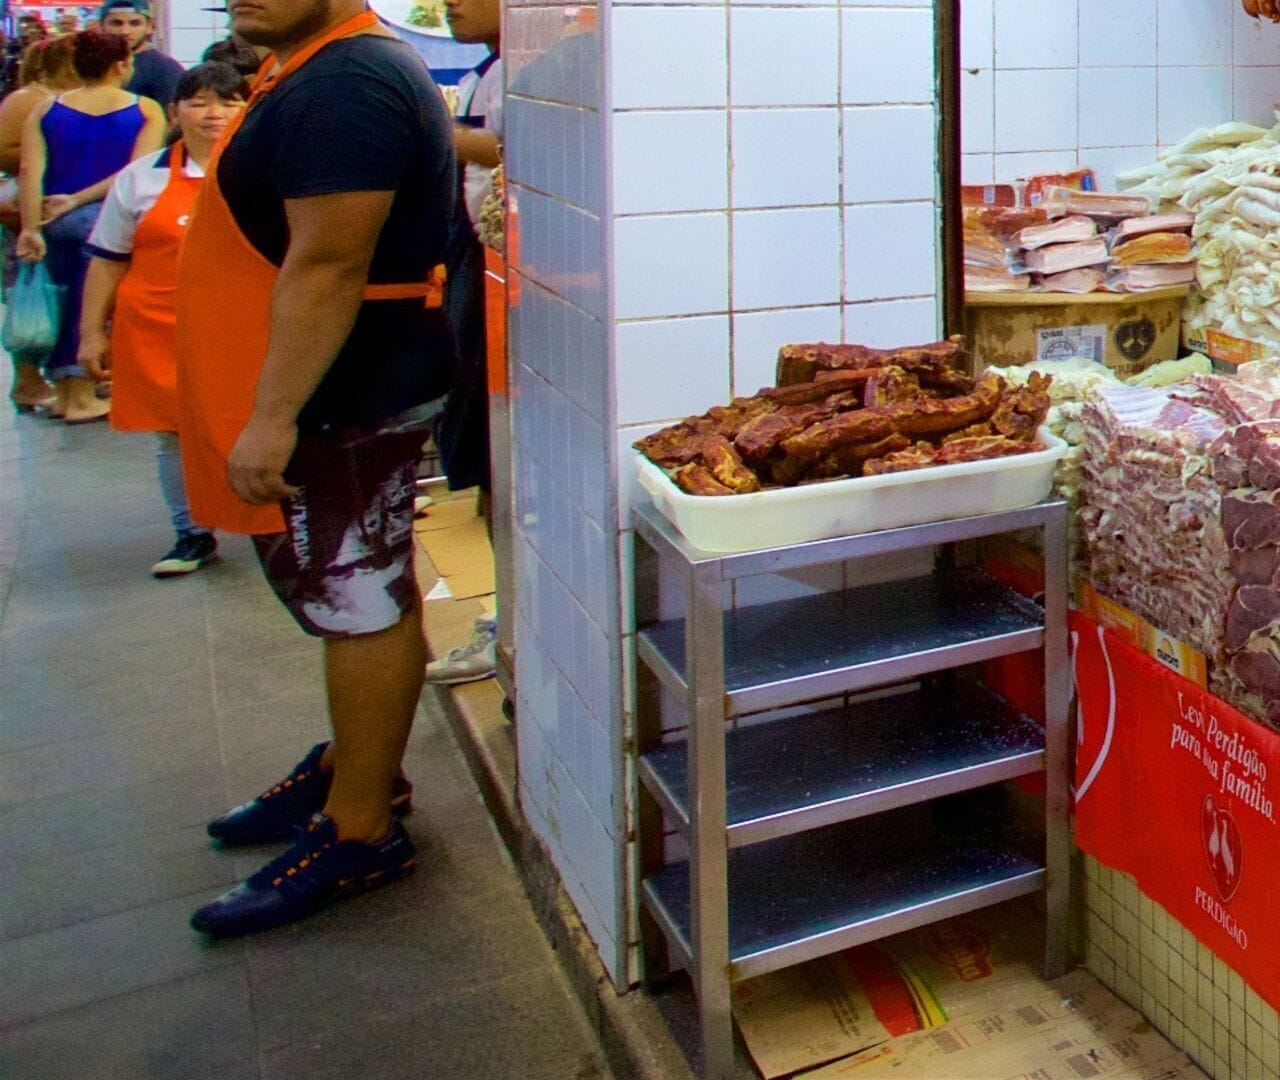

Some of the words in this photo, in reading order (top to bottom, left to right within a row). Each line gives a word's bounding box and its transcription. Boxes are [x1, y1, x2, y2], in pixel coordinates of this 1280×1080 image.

[1170, 723, 1202, 759] para
[1206, 714, 1268, 783] Perdigão
[1194, 886, 1249, 951] PERDIGÃO
